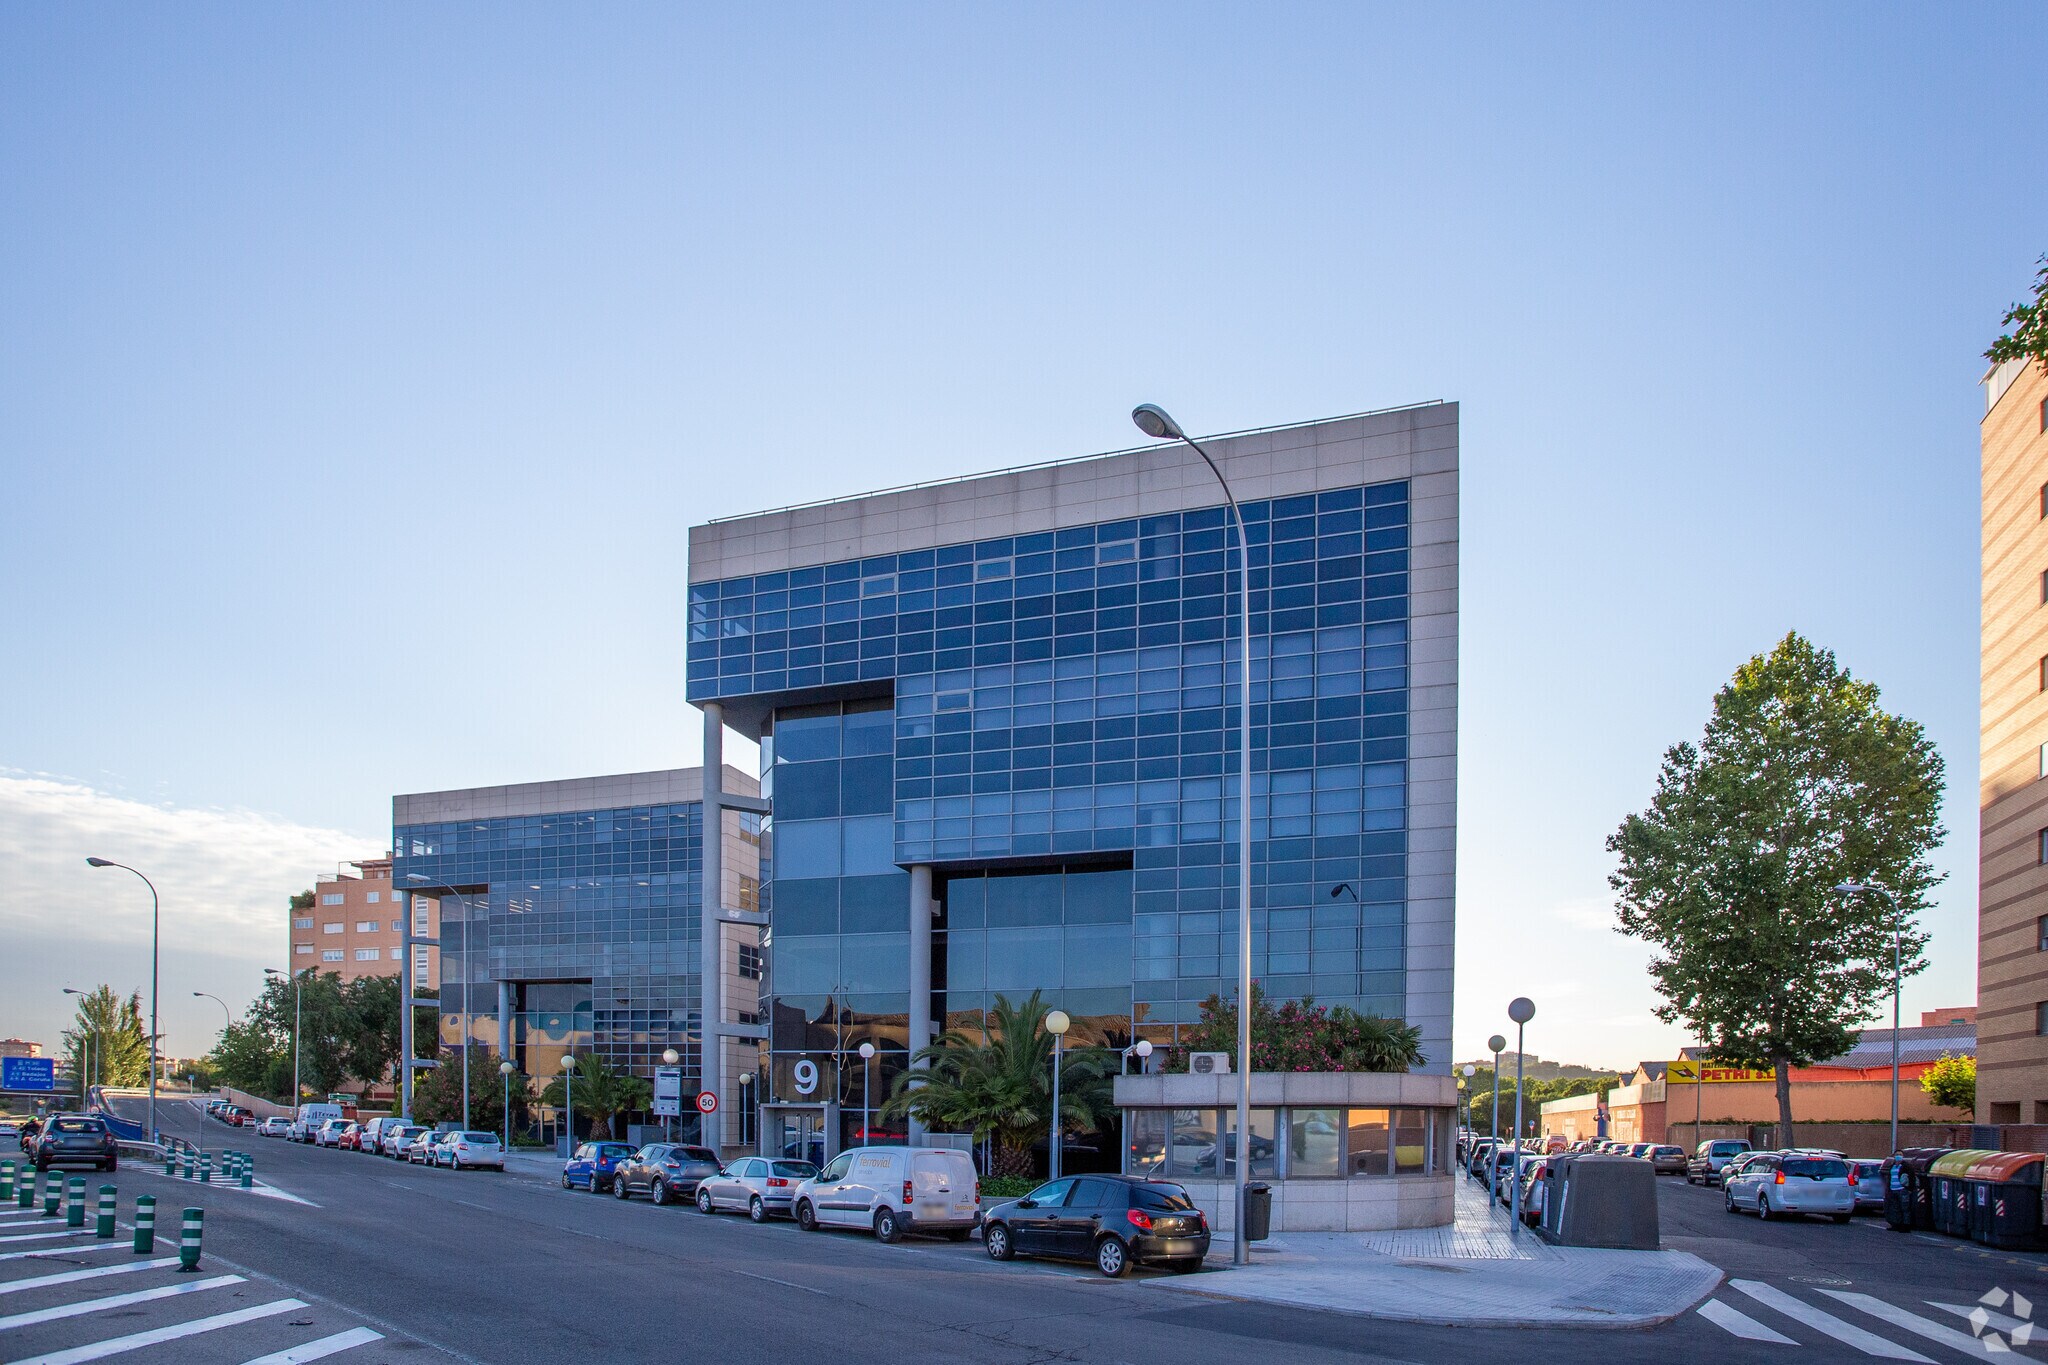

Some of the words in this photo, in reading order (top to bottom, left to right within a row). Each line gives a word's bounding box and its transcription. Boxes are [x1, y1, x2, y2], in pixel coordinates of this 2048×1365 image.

[794, 1059, 818, 1095] 9
[1701, 1070, 1750, 1080] PETRI
[860, 1156, 891, 1168] ferrovial
[954, 1203, 976, 1211] ferrovial
